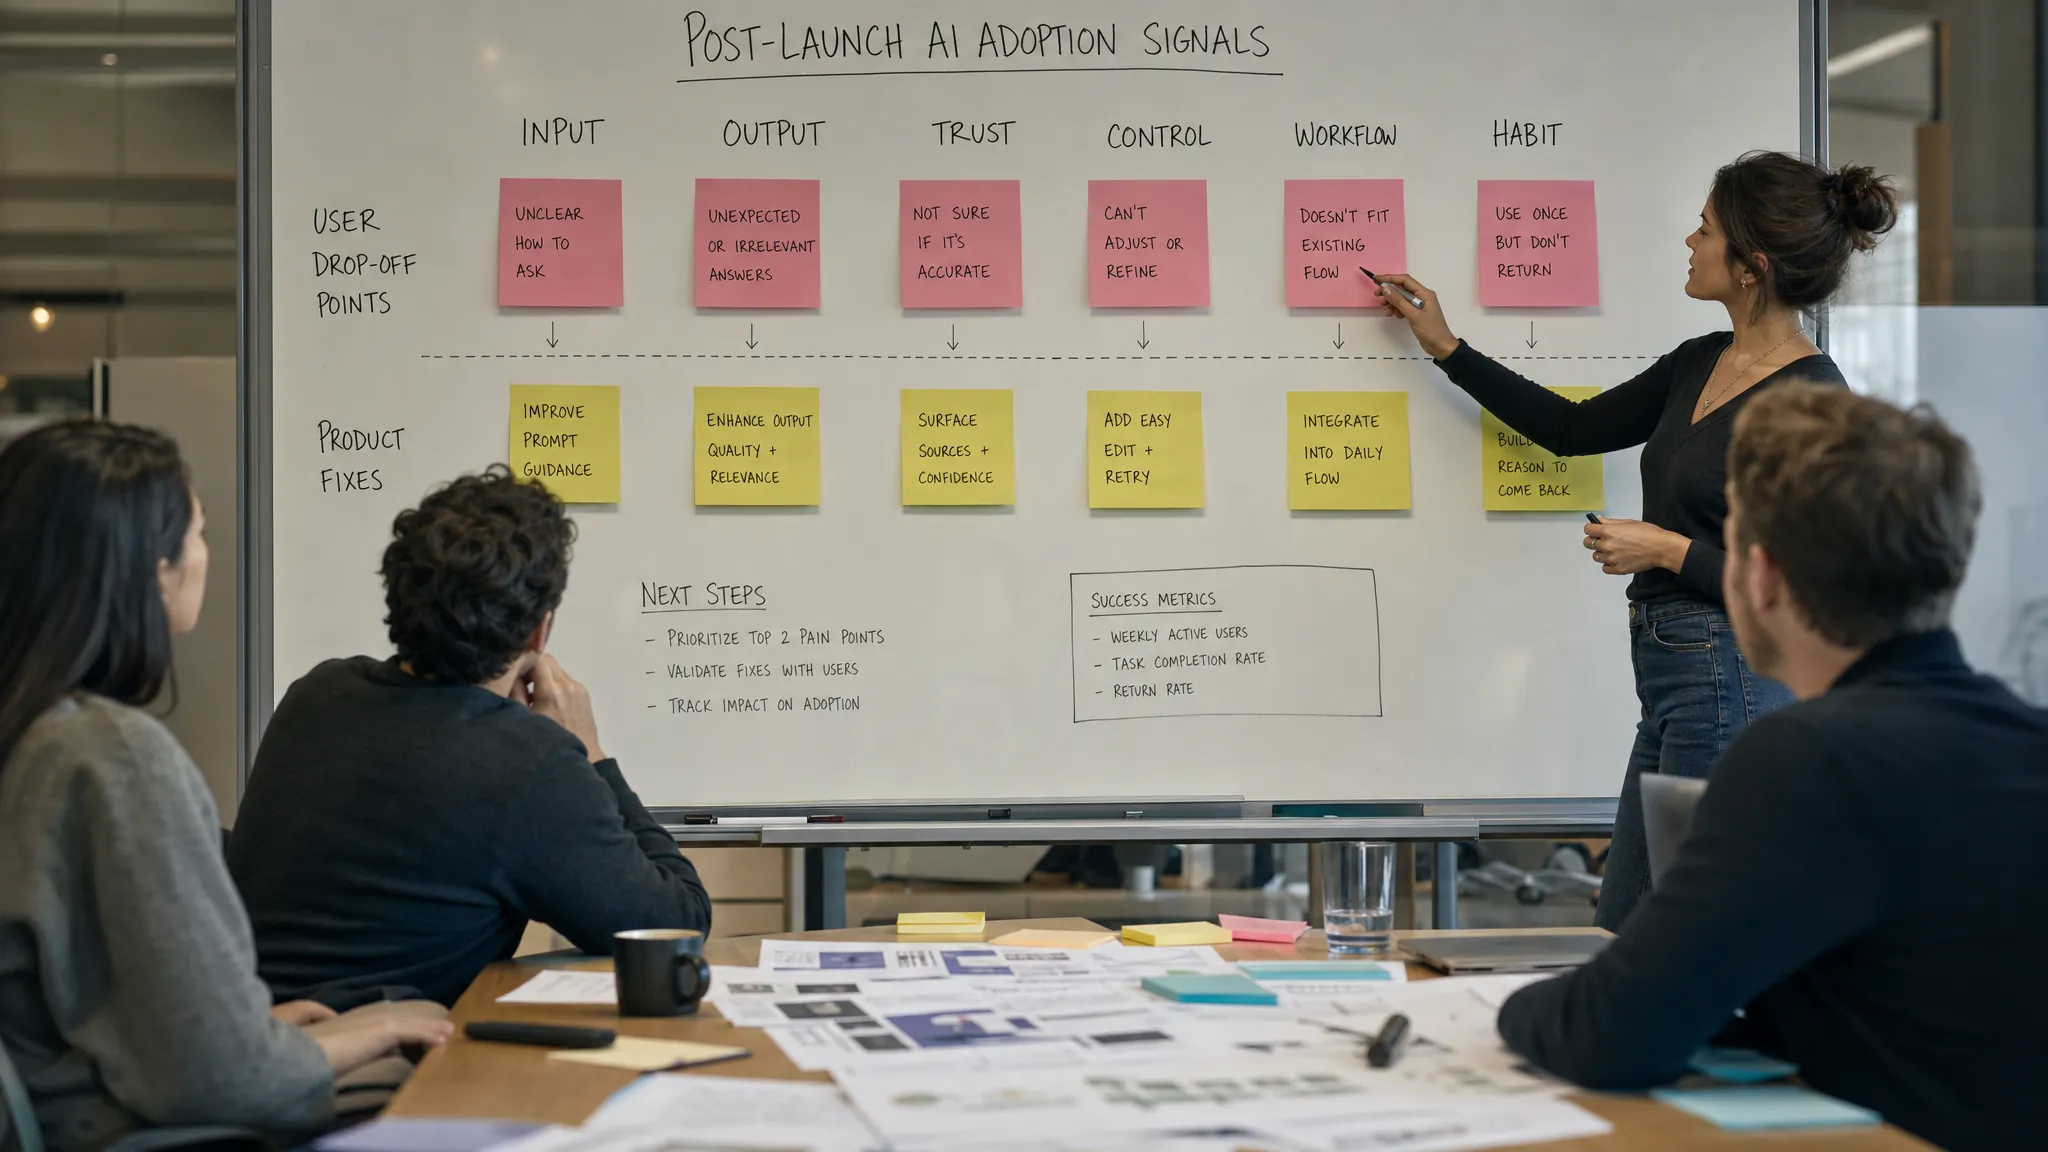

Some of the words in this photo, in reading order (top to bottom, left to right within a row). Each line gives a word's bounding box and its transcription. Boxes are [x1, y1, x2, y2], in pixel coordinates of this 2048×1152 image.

[683, 10, 903, 68] POST-LAUNCH
[927, 20, 959, 60] AI
[977, 21, 1116, 59] ADOPTION
[1143, 21, 1270, 58] SIGNALS
[522, 116, 606, 147] INPUT
[722, 118, 826, 147] OUTPUT
[931, 120, 1017, 146] TRUST
[1107, 123, 1213, 149] CONTROL
[1294, 121, 1397, 148] WORKFLOW
[1492, 118, 1564, 148] HABIT
[313, 207, 381, 235] USER
[515, 205, 585, 222] UNCLEAR
[708, 208, 801, 224] UNEXPECTED
[913, 205, 941, 221] NOT
[951, 205, 991, 221] SURE
[1103, 204, 1148, 221] CAN'T
[1299, 207, 1358, 224] DOESN'T
[1366, 208, 1390, 224] FIT
[1495, 206, 1522, 221] USE
[1532, 205, 1569, 221] ONCE
[515, 235, 544, 251] HOW
[551, 236, 570, 251] TO
[707, 239, 726, 253] OR
[735, 239, 817, 254] IRRELEVANT
[918, 234, 932, 250] IF
[942, 232, 966, 249] IT'S
[1104, 234, 1157, 251] ADJUST
[1166, 236, 1185, 251] OR
[1301, 237, 1366, 253] EXISTING
[1494, 234, 1522, 251] BUT
[1530, 232, 1570, 250] DON'T
[311, 251, 417, 278] DROP-OFF
[515, 263, 546, 279] ASK
[917, 263, 991, 280] ACCURATE
[1106, 263, 1159, 280] REFINE
[1303, 265, 1339, 280] FLOW
[1497, 262, 1552, 279] RETURN
[709, 267, 773, 282] ANSWERS
[316, 290, 392, 319] POINTS
[523, 402, 586, 420] IMPROVE
[918, 411, 978, 428] SURFACE
[706, 412, 766, 428] ENHANCE
[773, 413, 814, 428] OUTPUT
[1104, 411, 1132, 428] ADD
[1140, 413, 1172, 429] EASY
[1303, 413, 1380, 429] INTEGRATE
[317, 419, 406, 454] PRODUCT
[523, 431, 578, 449] PROMPT
[707, 442, 761, 459] QUALITY
[768, 445, 777, 456] +
[918, 443, 972, 458] SOURCES
[980, 445, 990, 456] +
[1104, 443, 1137, 458] EDIT
[1144, 445, 1154, 456] +
[1304, 445, 1334, 460] INTO
[1343, 445, 1384, 461] DAILY
[523, 461, 593, 477] GUIDANCE
[1497, 459, 1545, 474] REASON
[1551, 460, 1568, 474] TO
[320, 468, 383, 493] FIXES
[710, 469, 780, 485] RELEVANCE
[918, 470, 995, 485] CONFIDENCE
[1105, 469, 1151, 486] RETRY
[1304, 471, 1340, 486] FLOW
[1497, 483, 1532, 497] COME
[1538, 483, 1572, 497] BACK
[641, 581, 693, 608] NEXT
[705, 581, 767, 606] STEPS
[1091, 591, 1149, 609] SUCCESS
[1158, 591, 1217, 607] METRICS
[667, 628, 740, 648] PRIORITIZE
[748, 630, 772, 646] TOP
[781, 630, 791, 645] 2
[799, 627, 830, 645] PAIN
[841, 628, 885, 645] POINTS
[1110, 628, 1159, 644] WEEKLY
[1168, 627, 1209, 642] ACTIVE
[1215, 625, 1249, 640] USERS
[666, 663, 727, 679] VALIDATE
[736, 663, 771, 679] FIXES
[781, 662, 814, 677] WITH
[822, 661, 859, 677] USERS
[1111, 656, 1146, 672] TASK
[1153, 652, 1227, 669] COMPLETION
[1235, 651, 1267, 665] RATE
[1113, 683, 1157, 699] RETURN
[1166, 682, 1195, 696] RATE
[667, 697, 713, 715] TRACK
[722, 697, 769, 713] IMPACT
[777, 697, 793, 712] ON
[803, 695, 860, 712] ADOPTION
